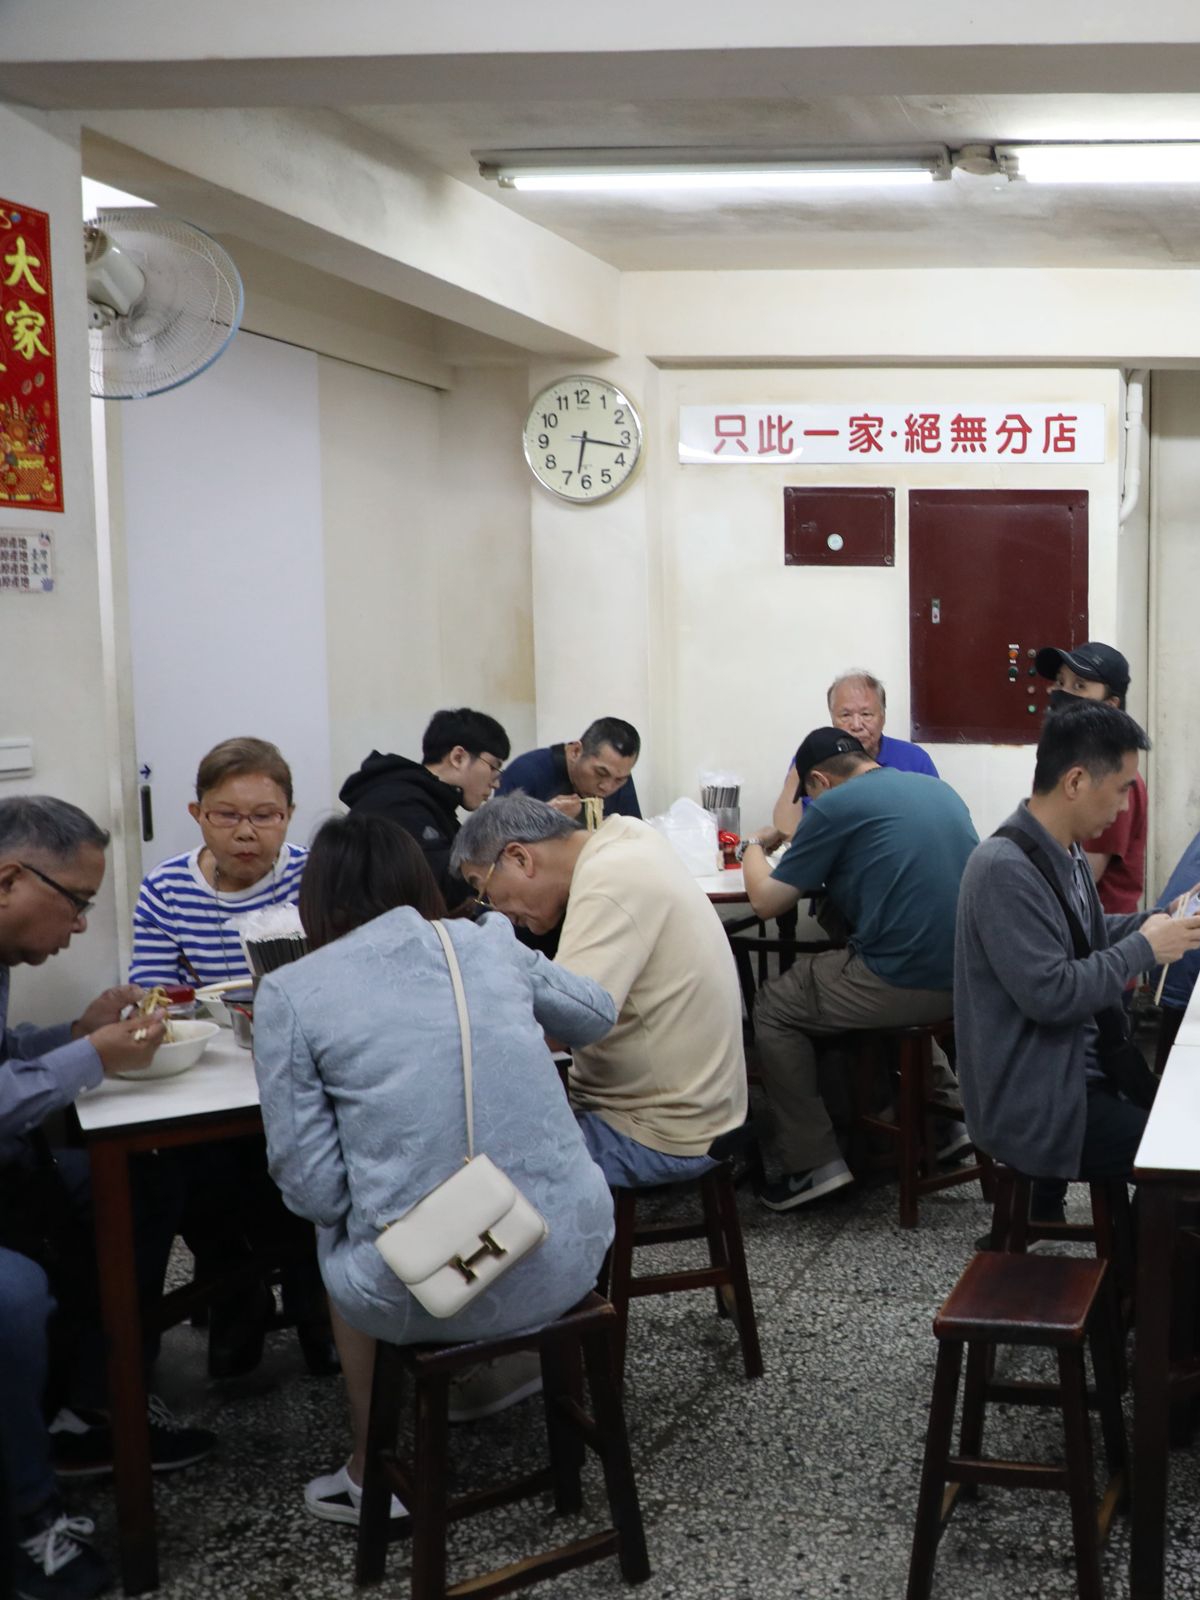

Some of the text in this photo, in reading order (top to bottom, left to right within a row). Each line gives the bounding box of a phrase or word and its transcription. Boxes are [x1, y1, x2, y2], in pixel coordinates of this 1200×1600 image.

[4, 236, 51, 361] 大家
[556, 395, 569, 410] 11
[574, 389, 590, 404] 12
[541, 413, 558, 428] 10
[614, 409, 625, 425] 2
[538, 434, 549, 449] 9
[620, 430, 631, 446] 3
[545, 454, 557, 469] 8
[614, 452, 626, 467] 4
[562, 470, 573, 485] 7
[581, 474, 592, 490] 6
[600, 469, 612, 484] 5
